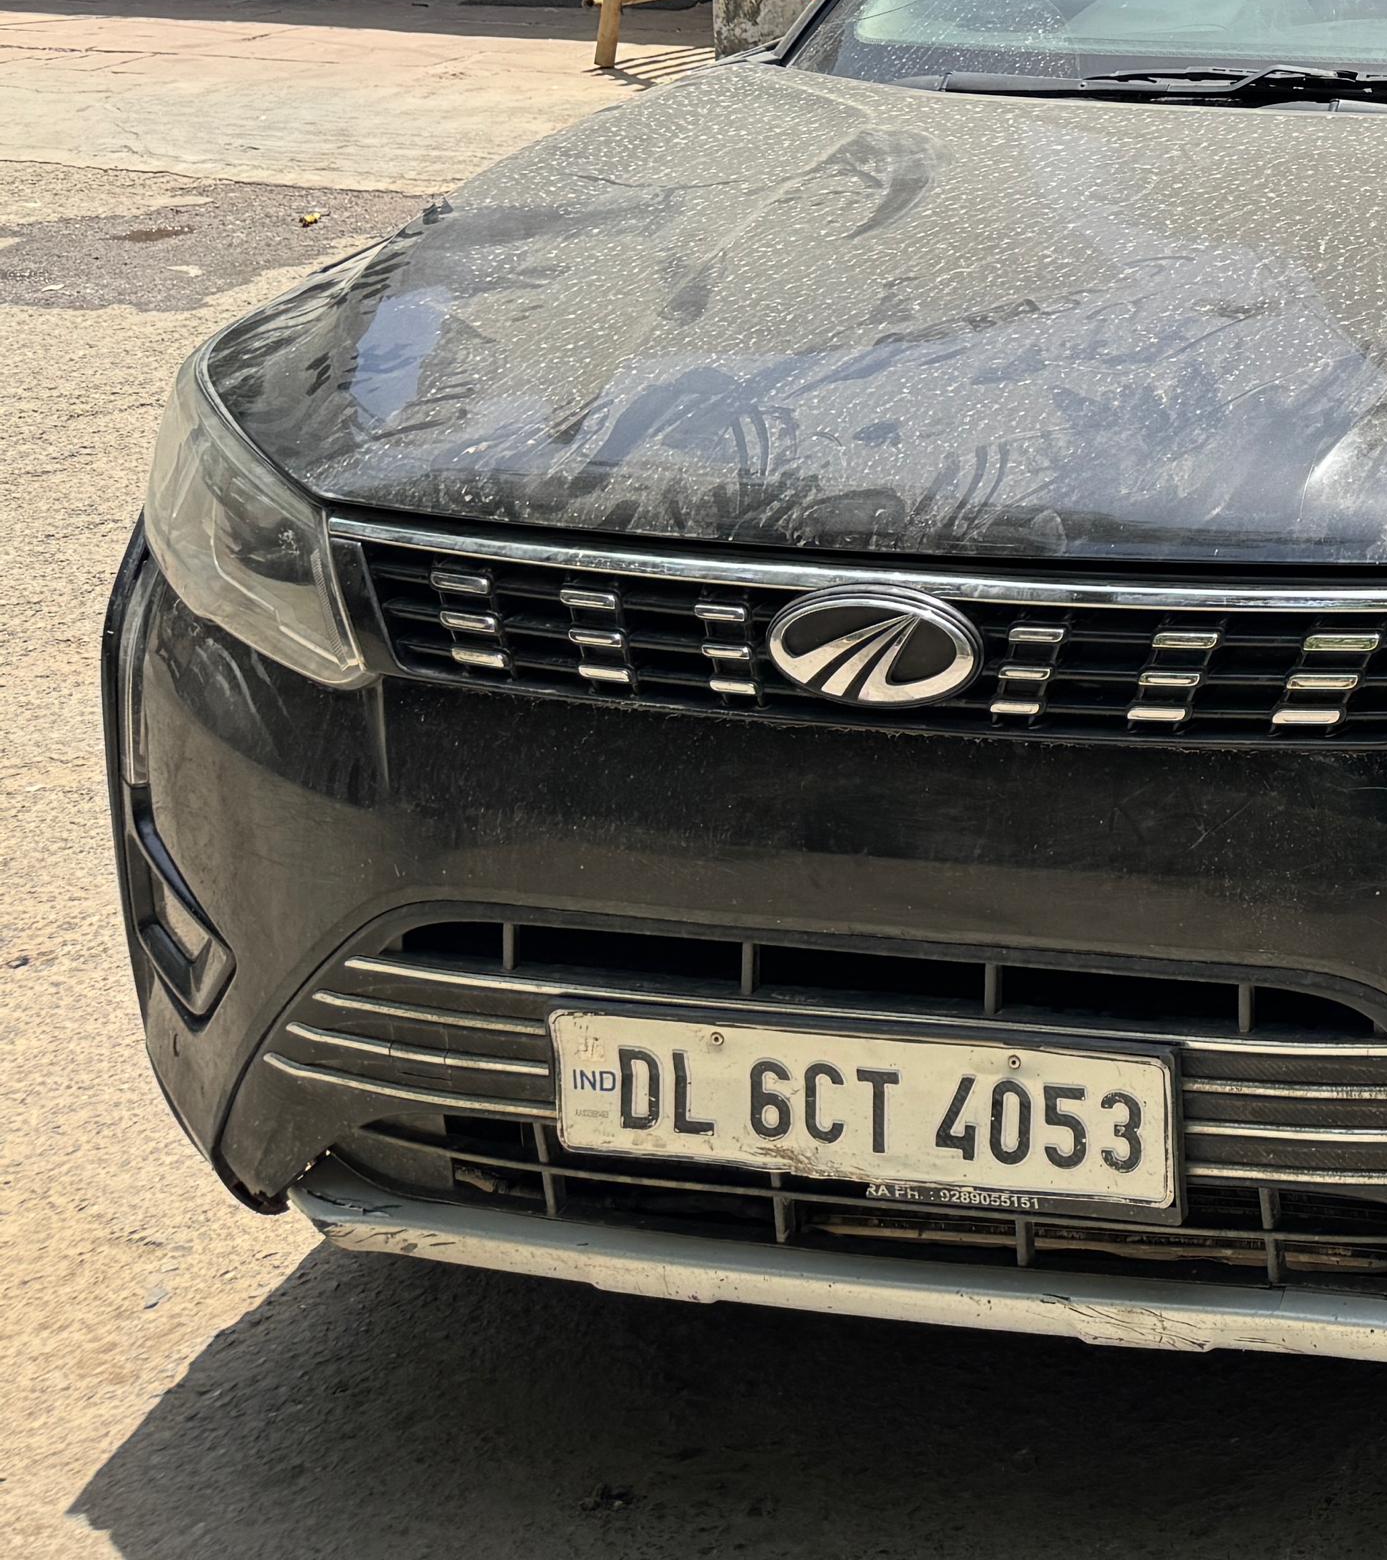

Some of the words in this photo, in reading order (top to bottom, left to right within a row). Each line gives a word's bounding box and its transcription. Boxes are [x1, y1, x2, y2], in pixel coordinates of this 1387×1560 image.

[573, 1068, 617, 1092] IND
[618, 1046, 716, 1137] DL
[748, 1056, 901, 1155] 6CT
[934, 1073, 1144, 1175] 4053
